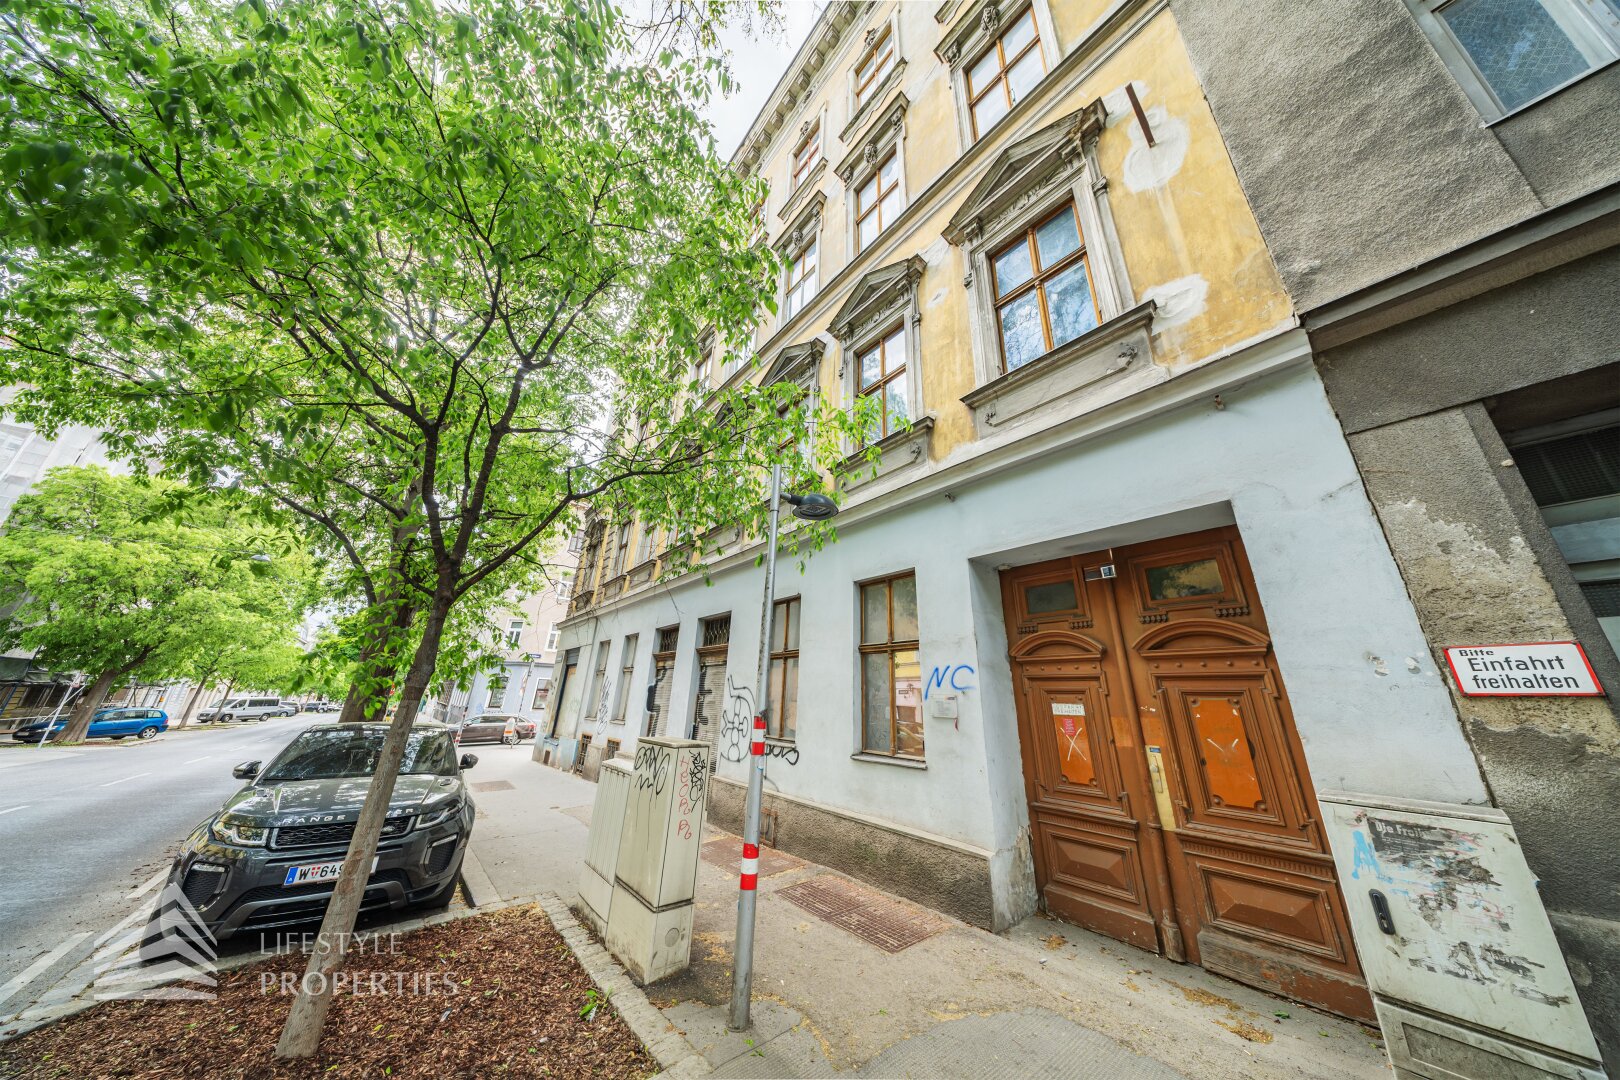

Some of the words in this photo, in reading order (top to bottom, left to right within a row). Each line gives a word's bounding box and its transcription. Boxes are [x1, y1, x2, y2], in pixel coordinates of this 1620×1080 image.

[1459, 649, 1494, 657] Bitte
[1467, 655, 1565, 672] Einfahrt
[1472, 674, 1580, 689] freihalten
[282, 814, 346, 824] RANGE
[298, 868, 311, 881] W
